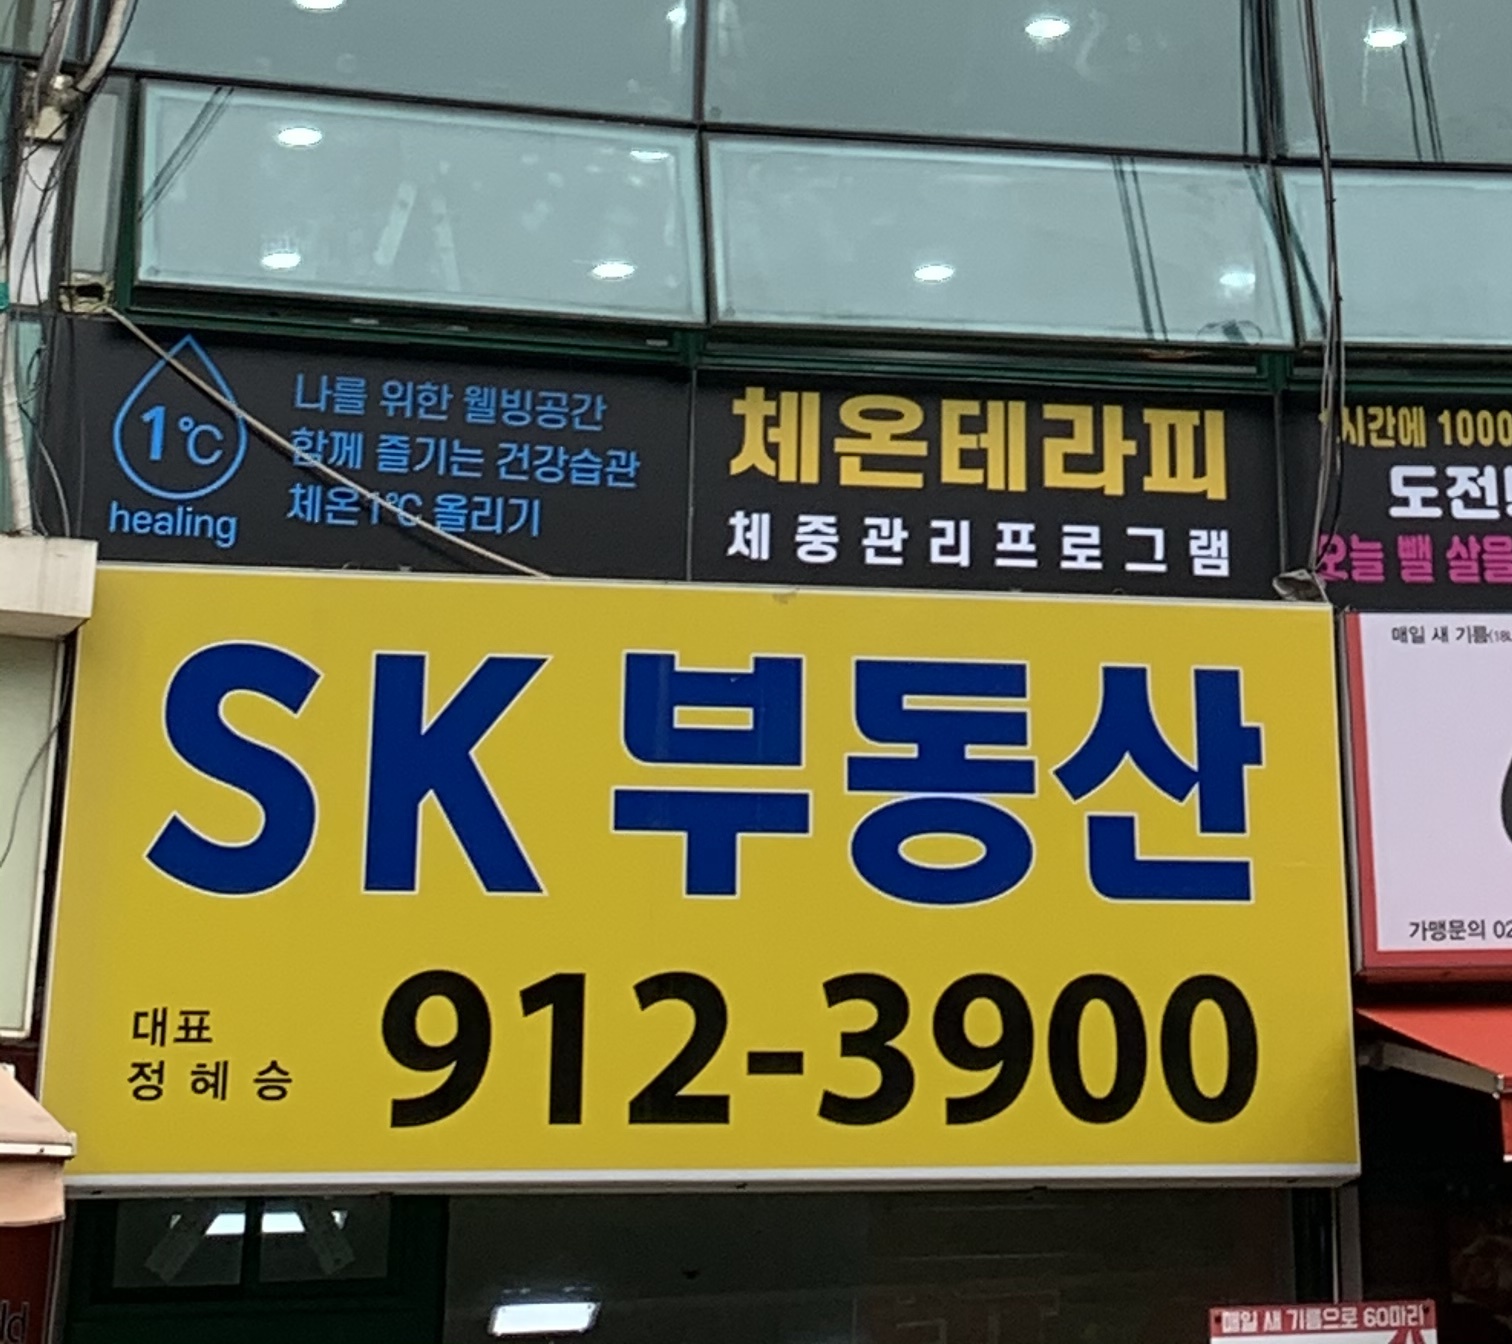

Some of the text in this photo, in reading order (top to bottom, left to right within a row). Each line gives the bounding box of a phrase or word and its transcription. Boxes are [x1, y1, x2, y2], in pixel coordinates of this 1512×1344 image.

[292, 373, 608, 432] 나를 위한 웰빙공간
[1318, 405, 1427, 449] 시간에
[290, 427, 641, 489] 함께 즐기는 건강습관
[728, 386, 1229, 501] 체온테라피
[108, 501, 238, 549] healing
[433, 493, 542, 538] 올리기
[1316, 533, 1386, 585] 오늘
[1390, 624, 1426, 645] 매일
[1431, 624, 1449, 644] 새
[143, 639, 1266, 909] SK 부동산
[1408, 919, 1487, 942] 가맹문의
[131, 1006, 215, 1048] 대표
[379, 968, 1261, 1130] 912-3900
